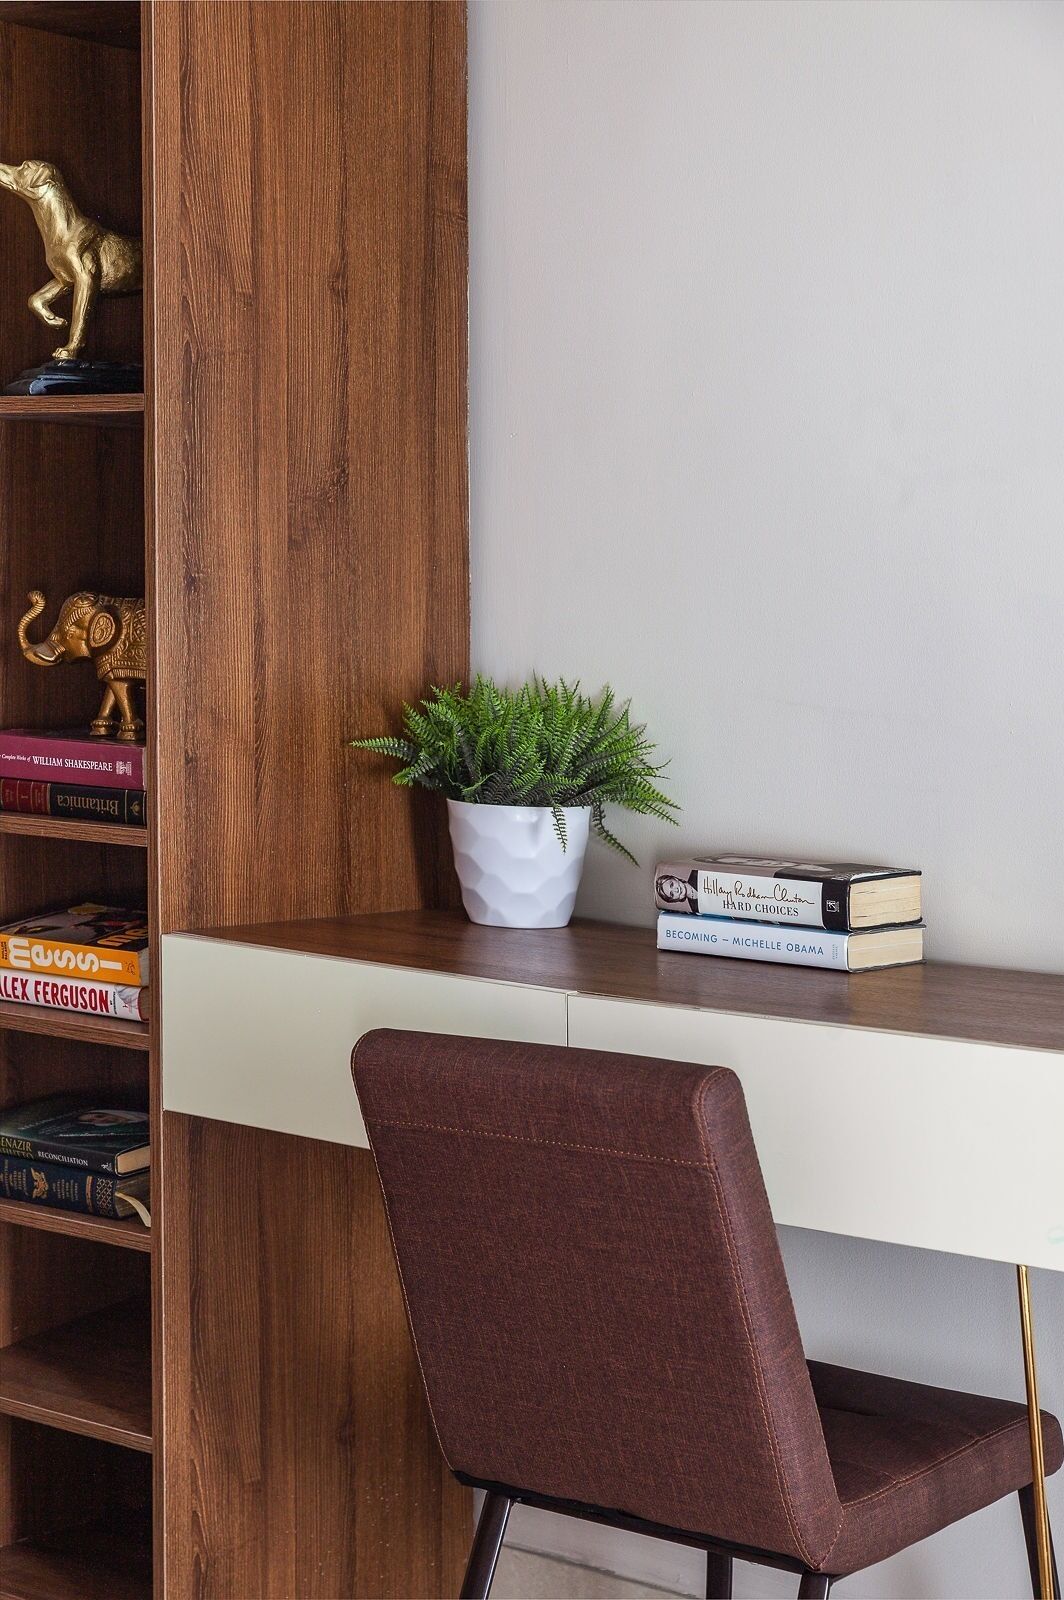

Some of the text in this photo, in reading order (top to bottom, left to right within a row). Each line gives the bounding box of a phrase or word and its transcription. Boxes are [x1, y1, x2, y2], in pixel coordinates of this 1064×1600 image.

[32, 755, 63, 767] WILLIAM
[64, 758, 113, 772] SHAKESPEARE
[57, 795, 119, 815] Britannica
[723, 900, 799, 916] HARD CHOICES
[665, 929, 718, 943] BECOMING
[732, 936, 782, 951] MICHELLE
[786, 942, 824, 956] OBAMA
[34, 980, 110, 1013] FERGUSON
[0, 1136, 32, 1152] ENAZIR
[38, 1151, 89, 1167] RECONCILIATION
